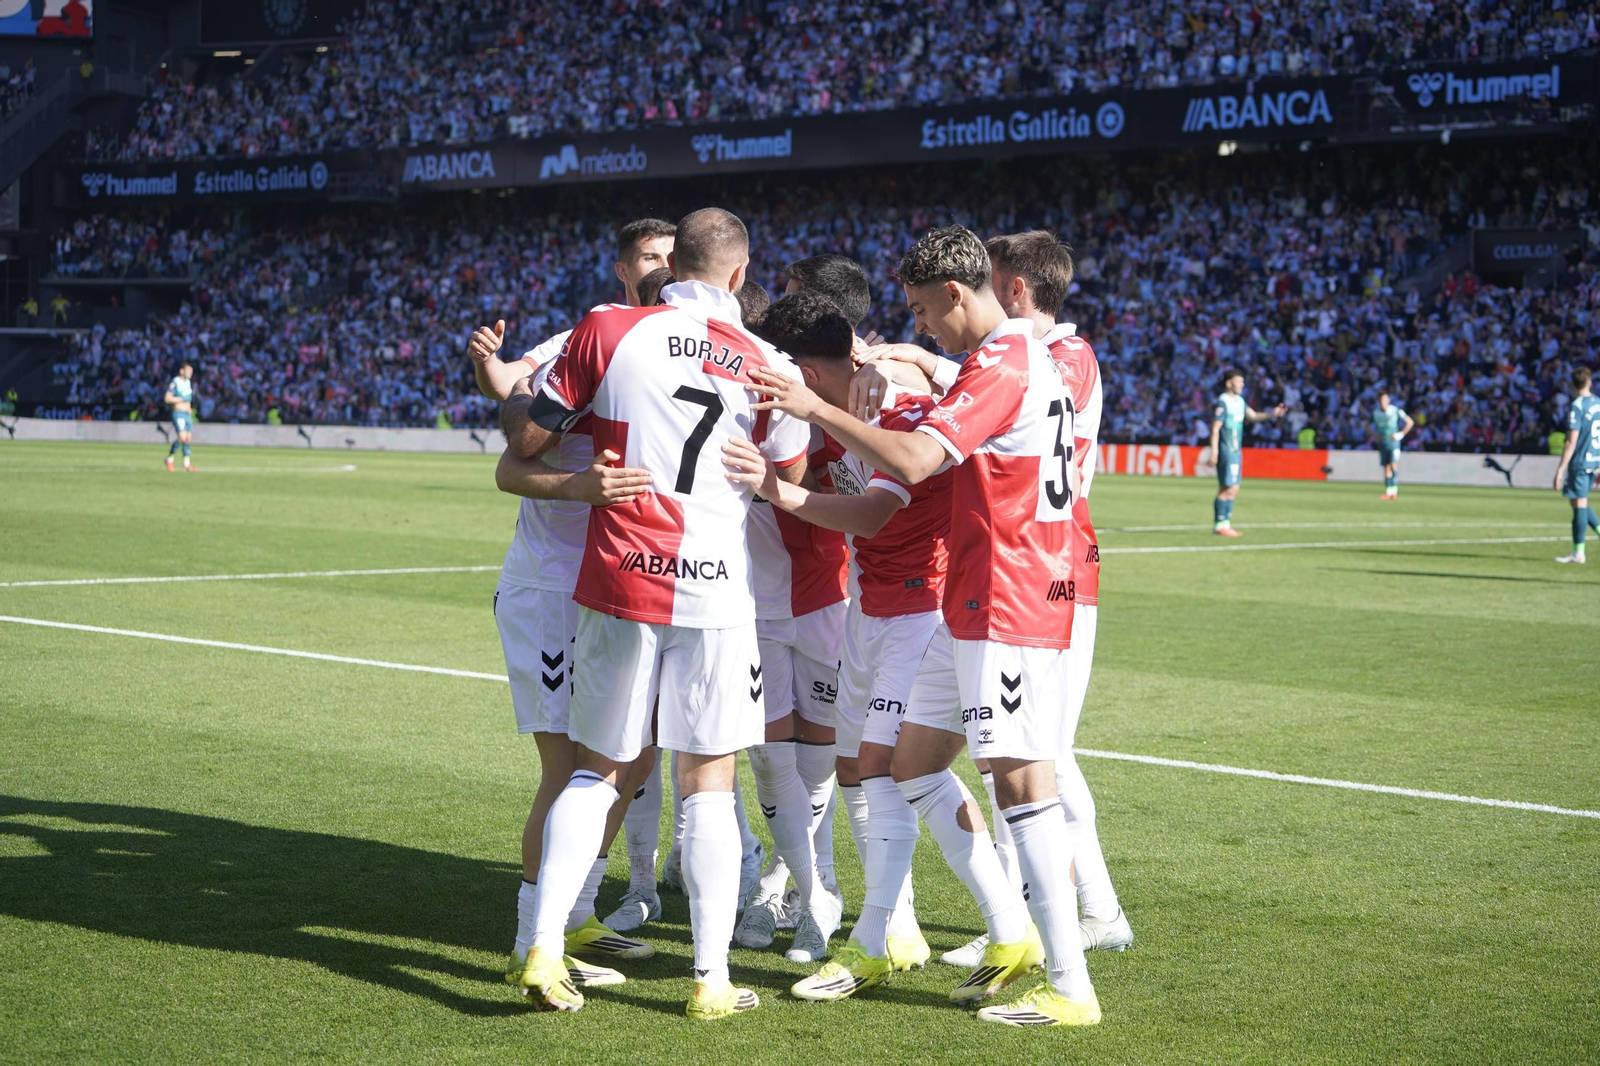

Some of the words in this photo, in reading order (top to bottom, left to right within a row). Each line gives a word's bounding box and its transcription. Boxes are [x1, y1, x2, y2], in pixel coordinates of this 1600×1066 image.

[1446, 65, 1560, 104] hummel
[716, 129, 792, 160] hummel
[921, 116, 1005, 149] Estrella
[1008, 107, 1091, 142] Galicia
[581, 144, 647, 174] método
[106, 171, 177, 196] hummel
[194, 170, 253, 194] Estrella
[256, 165, 307, 191] Galicia
[668, 336, 743, 376] BORJA
[672, 384, 724, 495] 7
